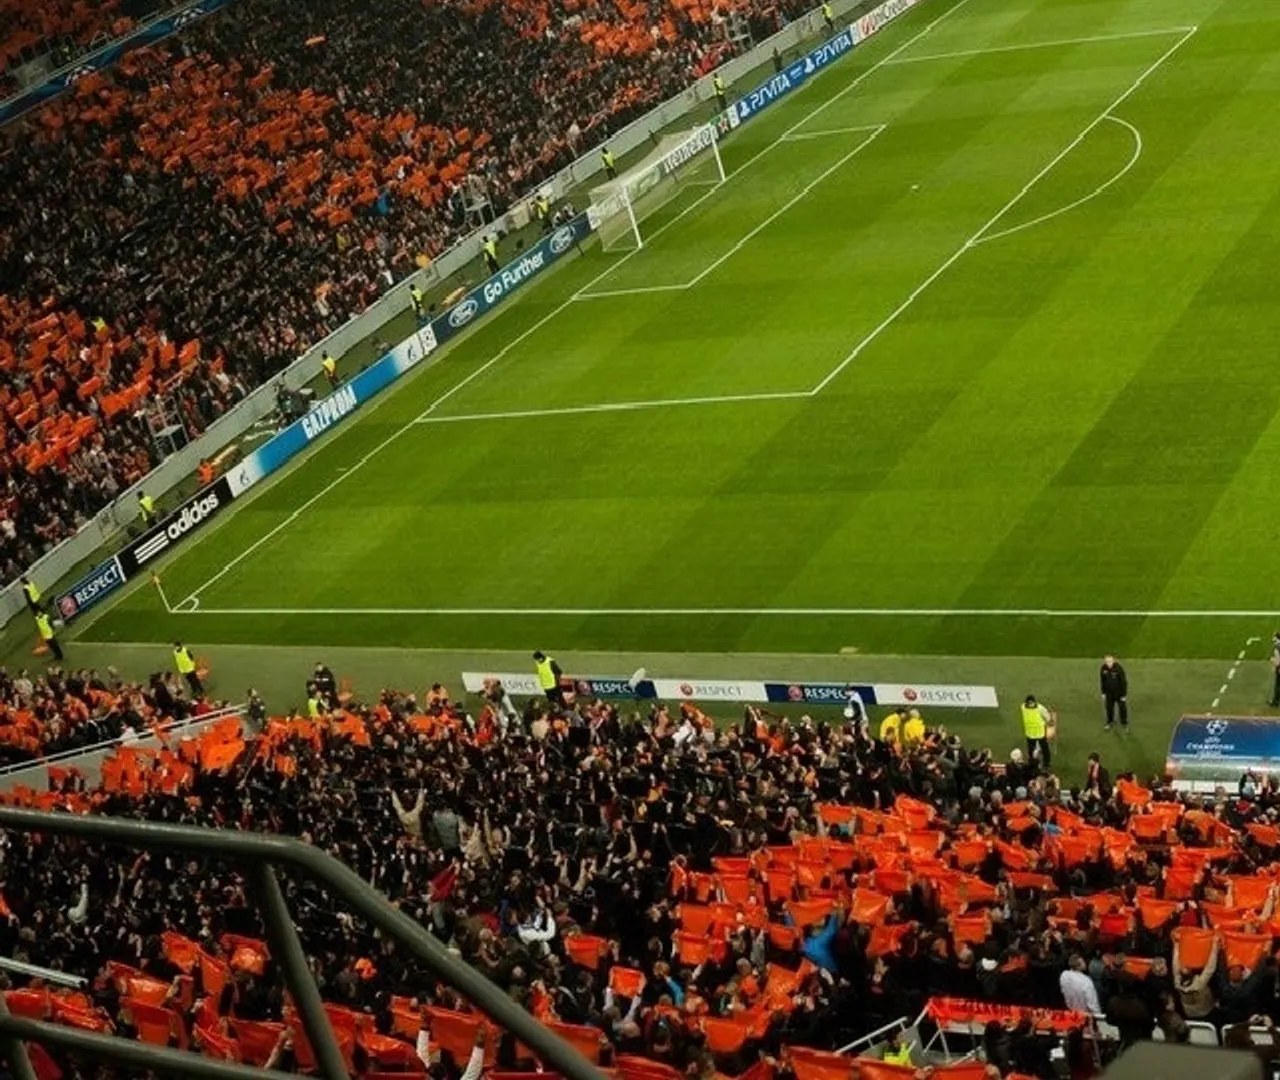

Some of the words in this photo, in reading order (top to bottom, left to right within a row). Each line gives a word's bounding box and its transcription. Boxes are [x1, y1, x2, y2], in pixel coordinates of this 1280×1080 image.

[483, 281, 503, 304] Go
[501, 251, 545, 291] Further
[301, 384, 358, 440] GAZPROM
[167, 493, 219, 540] adidas
[74, 564, 119, 606] RESPECT
[695, 686, 741, 697] RESPECT
[804, 687, 848, 699] RESPEC
[920, 690, 971, 702] RESPECT
